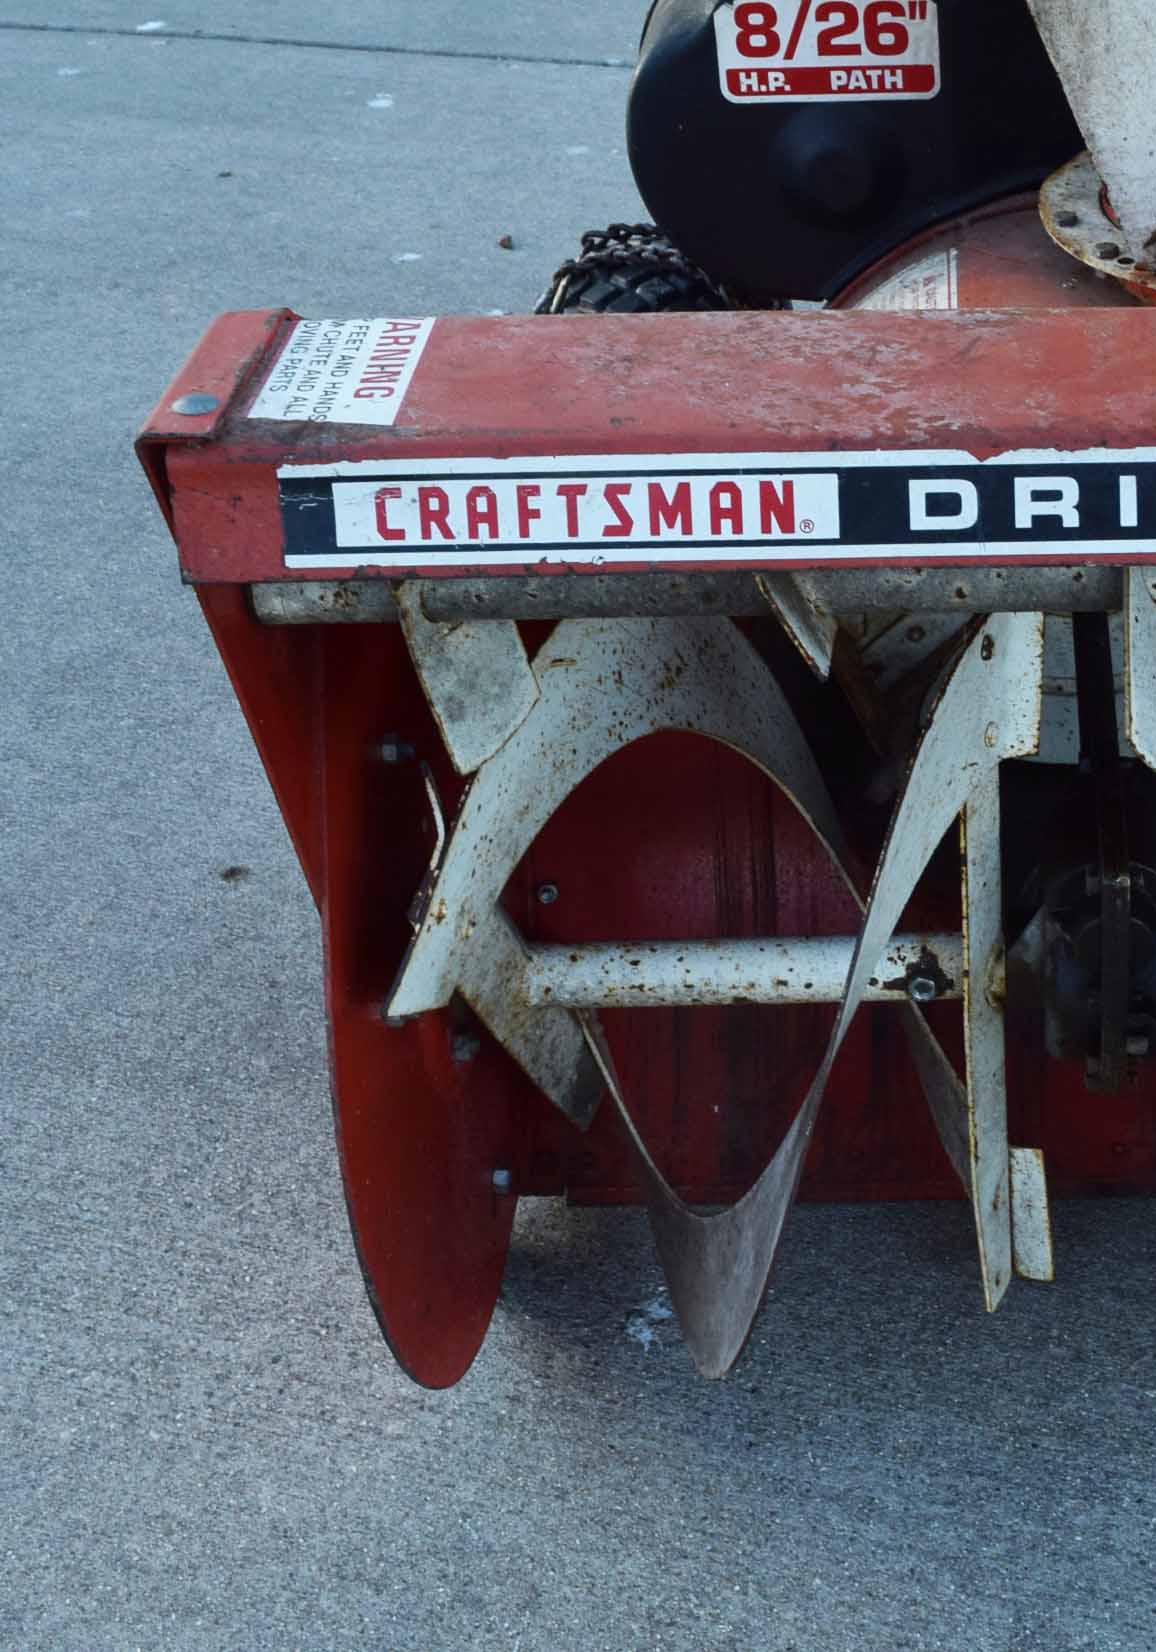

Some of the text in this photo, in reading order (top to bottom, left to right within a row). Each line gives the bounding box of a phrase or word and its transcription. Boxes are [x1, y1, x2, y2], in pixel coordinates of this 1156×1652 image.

[733, 0, 927, 60] 8/26"
[738, 69, 904, 93] H.P. PATH
[308, 331, 341, 367] CHUTE
[343, 324, 370, 352] FEET
[269, 321, 321, 393] OVING PARTS
[330, 355, 353, 377] AND
[353, 320, 421, 399] ARNING
[296, 369, 319, 392] AND
[281, 396, 307, 417] ALL
[307, 381, 343, 422] HANDS
